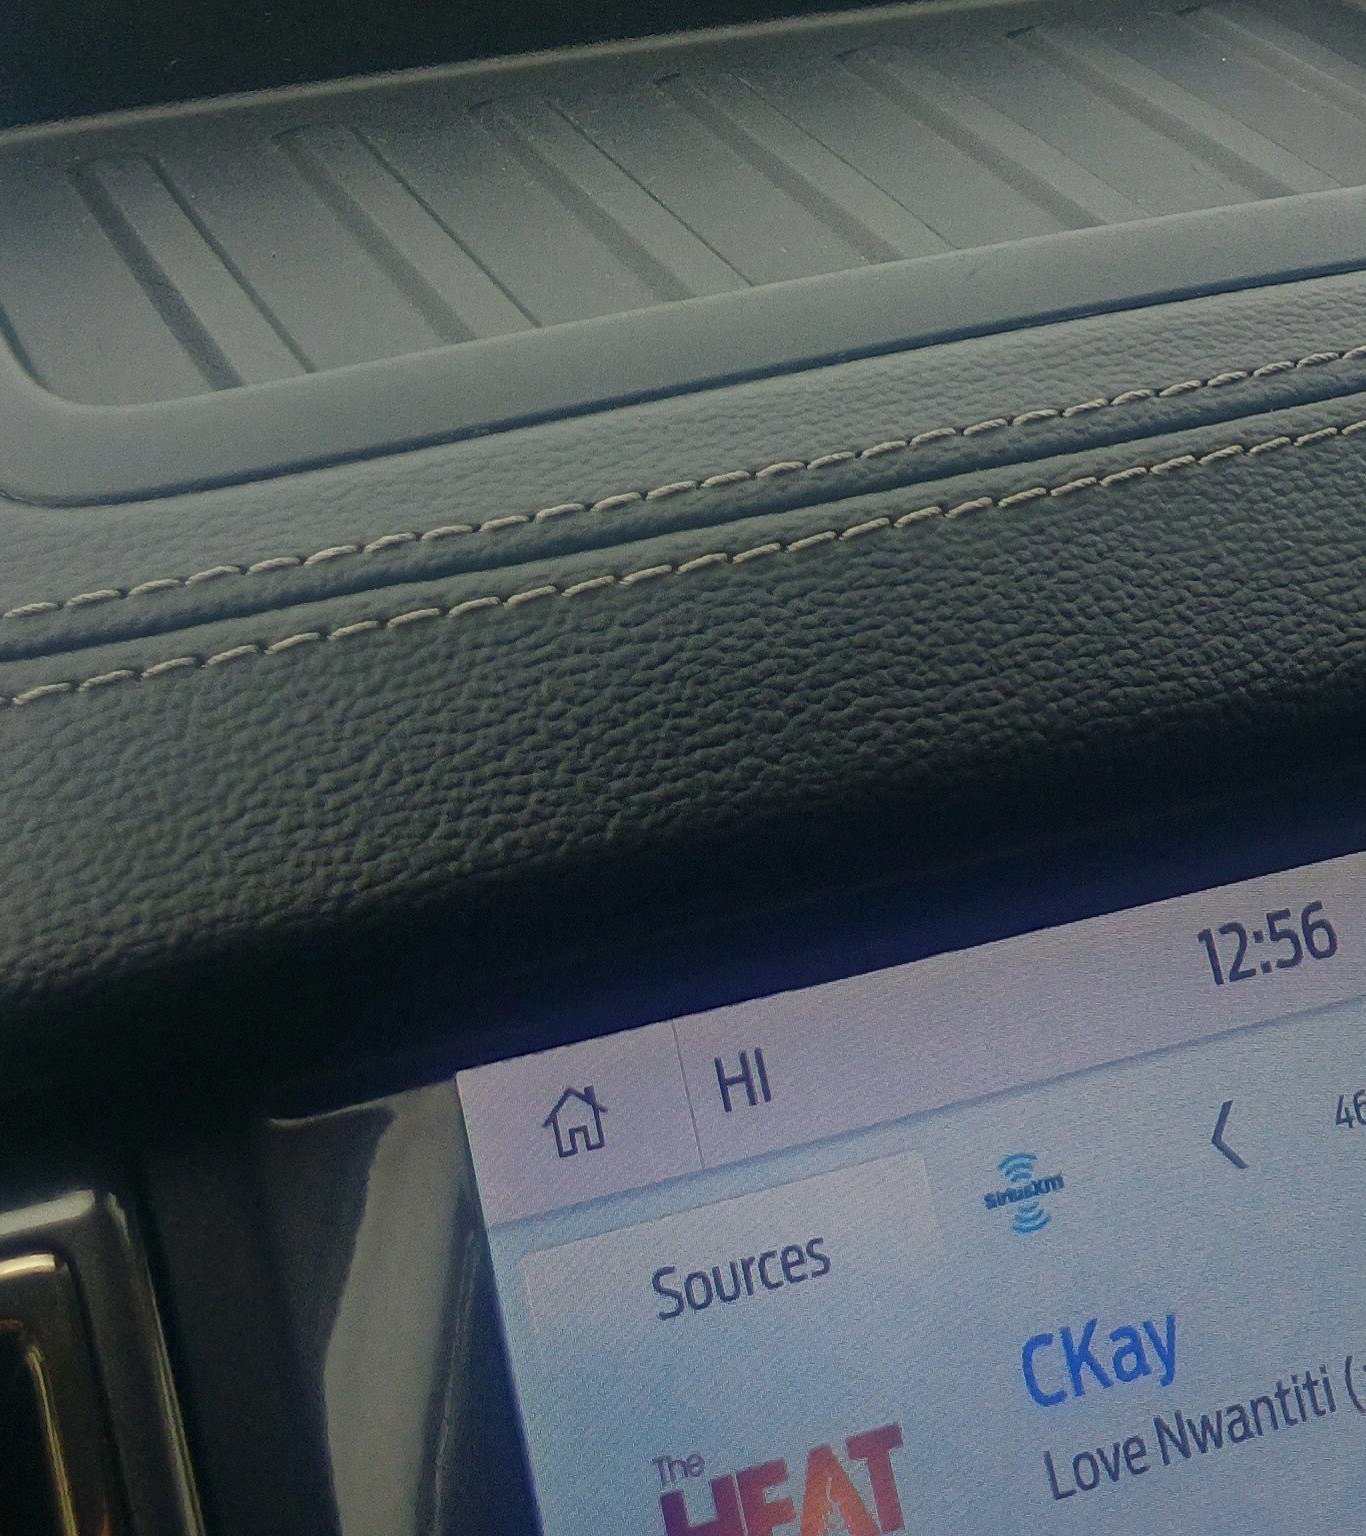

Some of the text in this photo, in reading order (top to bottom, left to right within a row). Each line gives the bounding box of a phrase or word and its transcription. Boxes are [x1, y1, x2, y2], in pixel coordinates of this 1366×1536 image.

[1197, 900, 1339, 986] 12:56
[714, 1046, 772, 1112] HI
[650, 1236, 832, 1322] Sources
[1021, 1312, 1177, 1408] CKay
[1043, 1430, 1151, 1502] Love
[1151, 1362, 1337, 1468] Nwantiti
[650, 1421, 907, 1536] The HEAT
